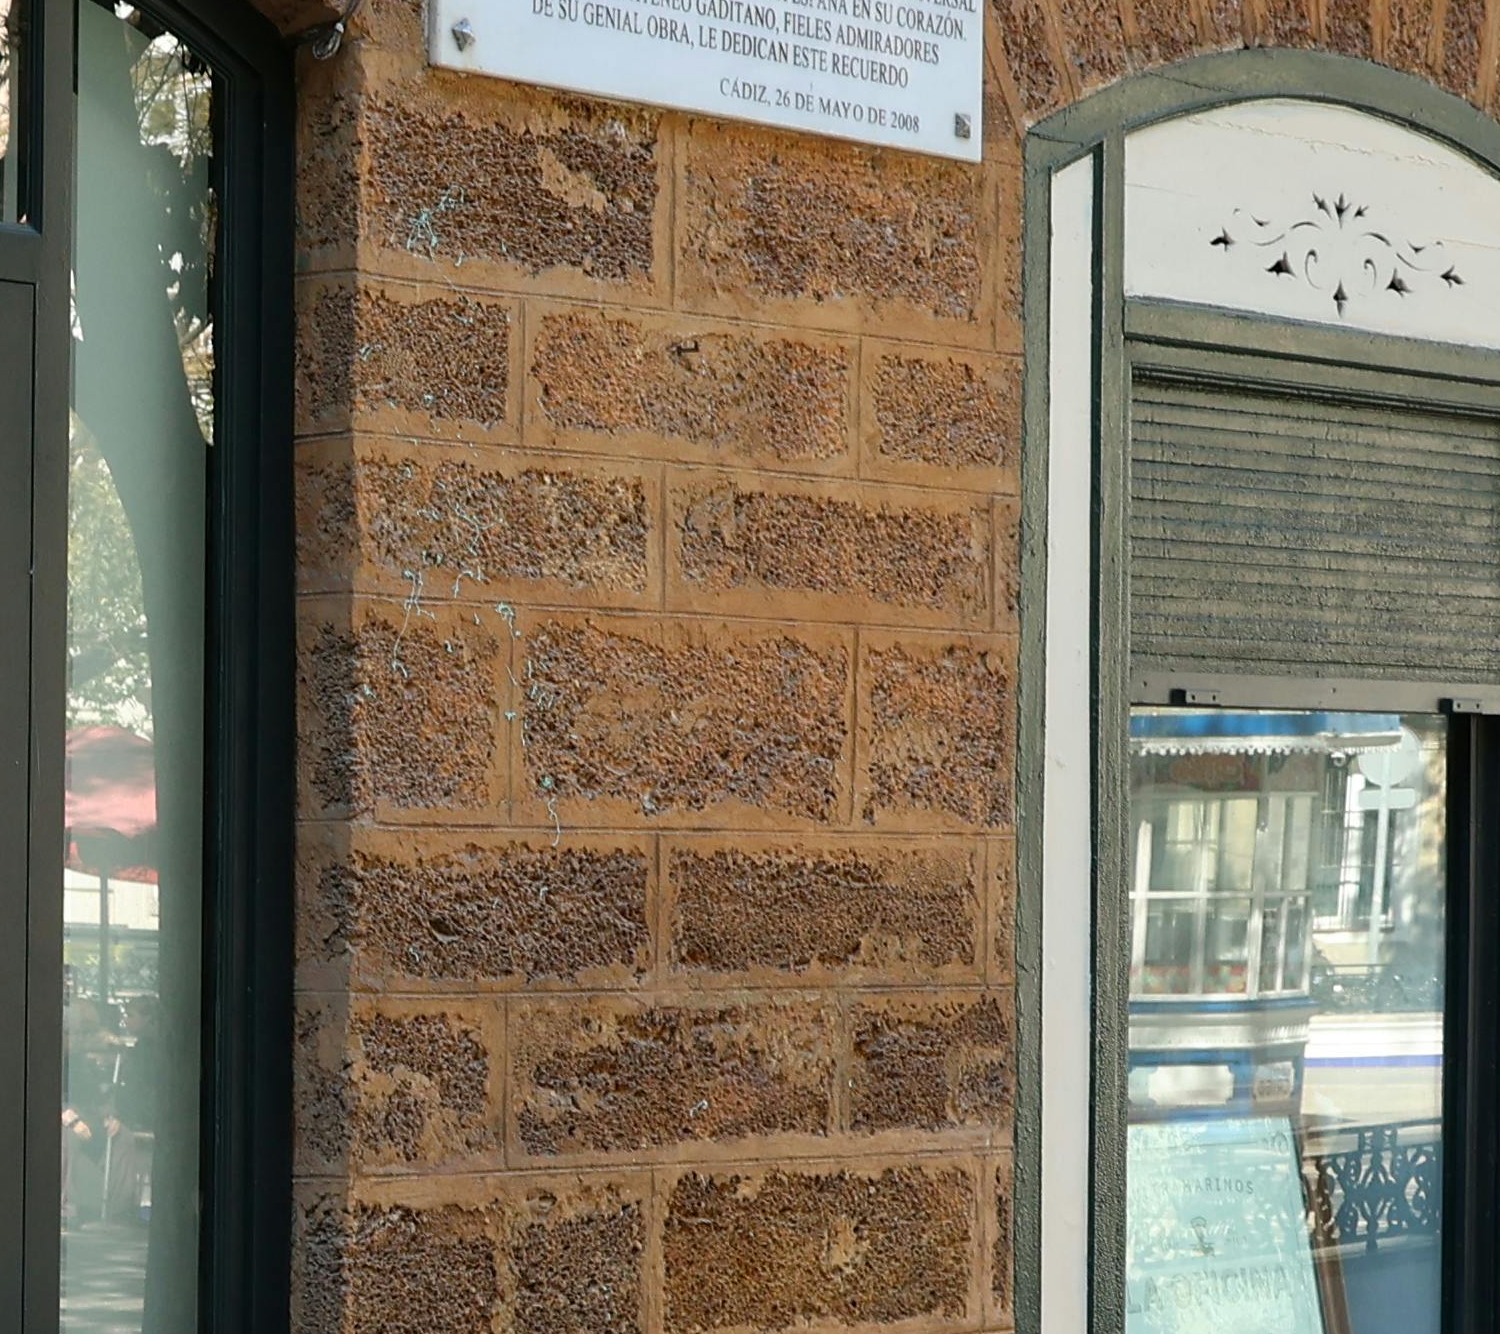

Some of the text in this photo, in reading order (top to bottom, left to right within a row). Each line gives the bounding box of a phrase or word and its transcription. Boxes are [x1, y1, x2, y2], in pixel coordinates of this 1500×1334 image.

[582, 1, 642, 34] GENIAL
[646, 14, 694, 47] OBRA,
[698, 24, 717, 49] LE
[721, 29, 788, 63] DEDICAN
[792, 44, 827, 72] ESTE
[831, 52, 908, 88] RECUERDO
[783, 10, 831, 42] FIELES
[835, 23, 939, 65] ADMIRADORES
[874, 0, 893, 24] SU
[896, 5, 967, 41] CORAZÓN.
[719, 77, 919, 133] CÁDIZ, 26 DE MAYO DE 2008
[1135, 1176, 1255, 1197] TRMARINOS
